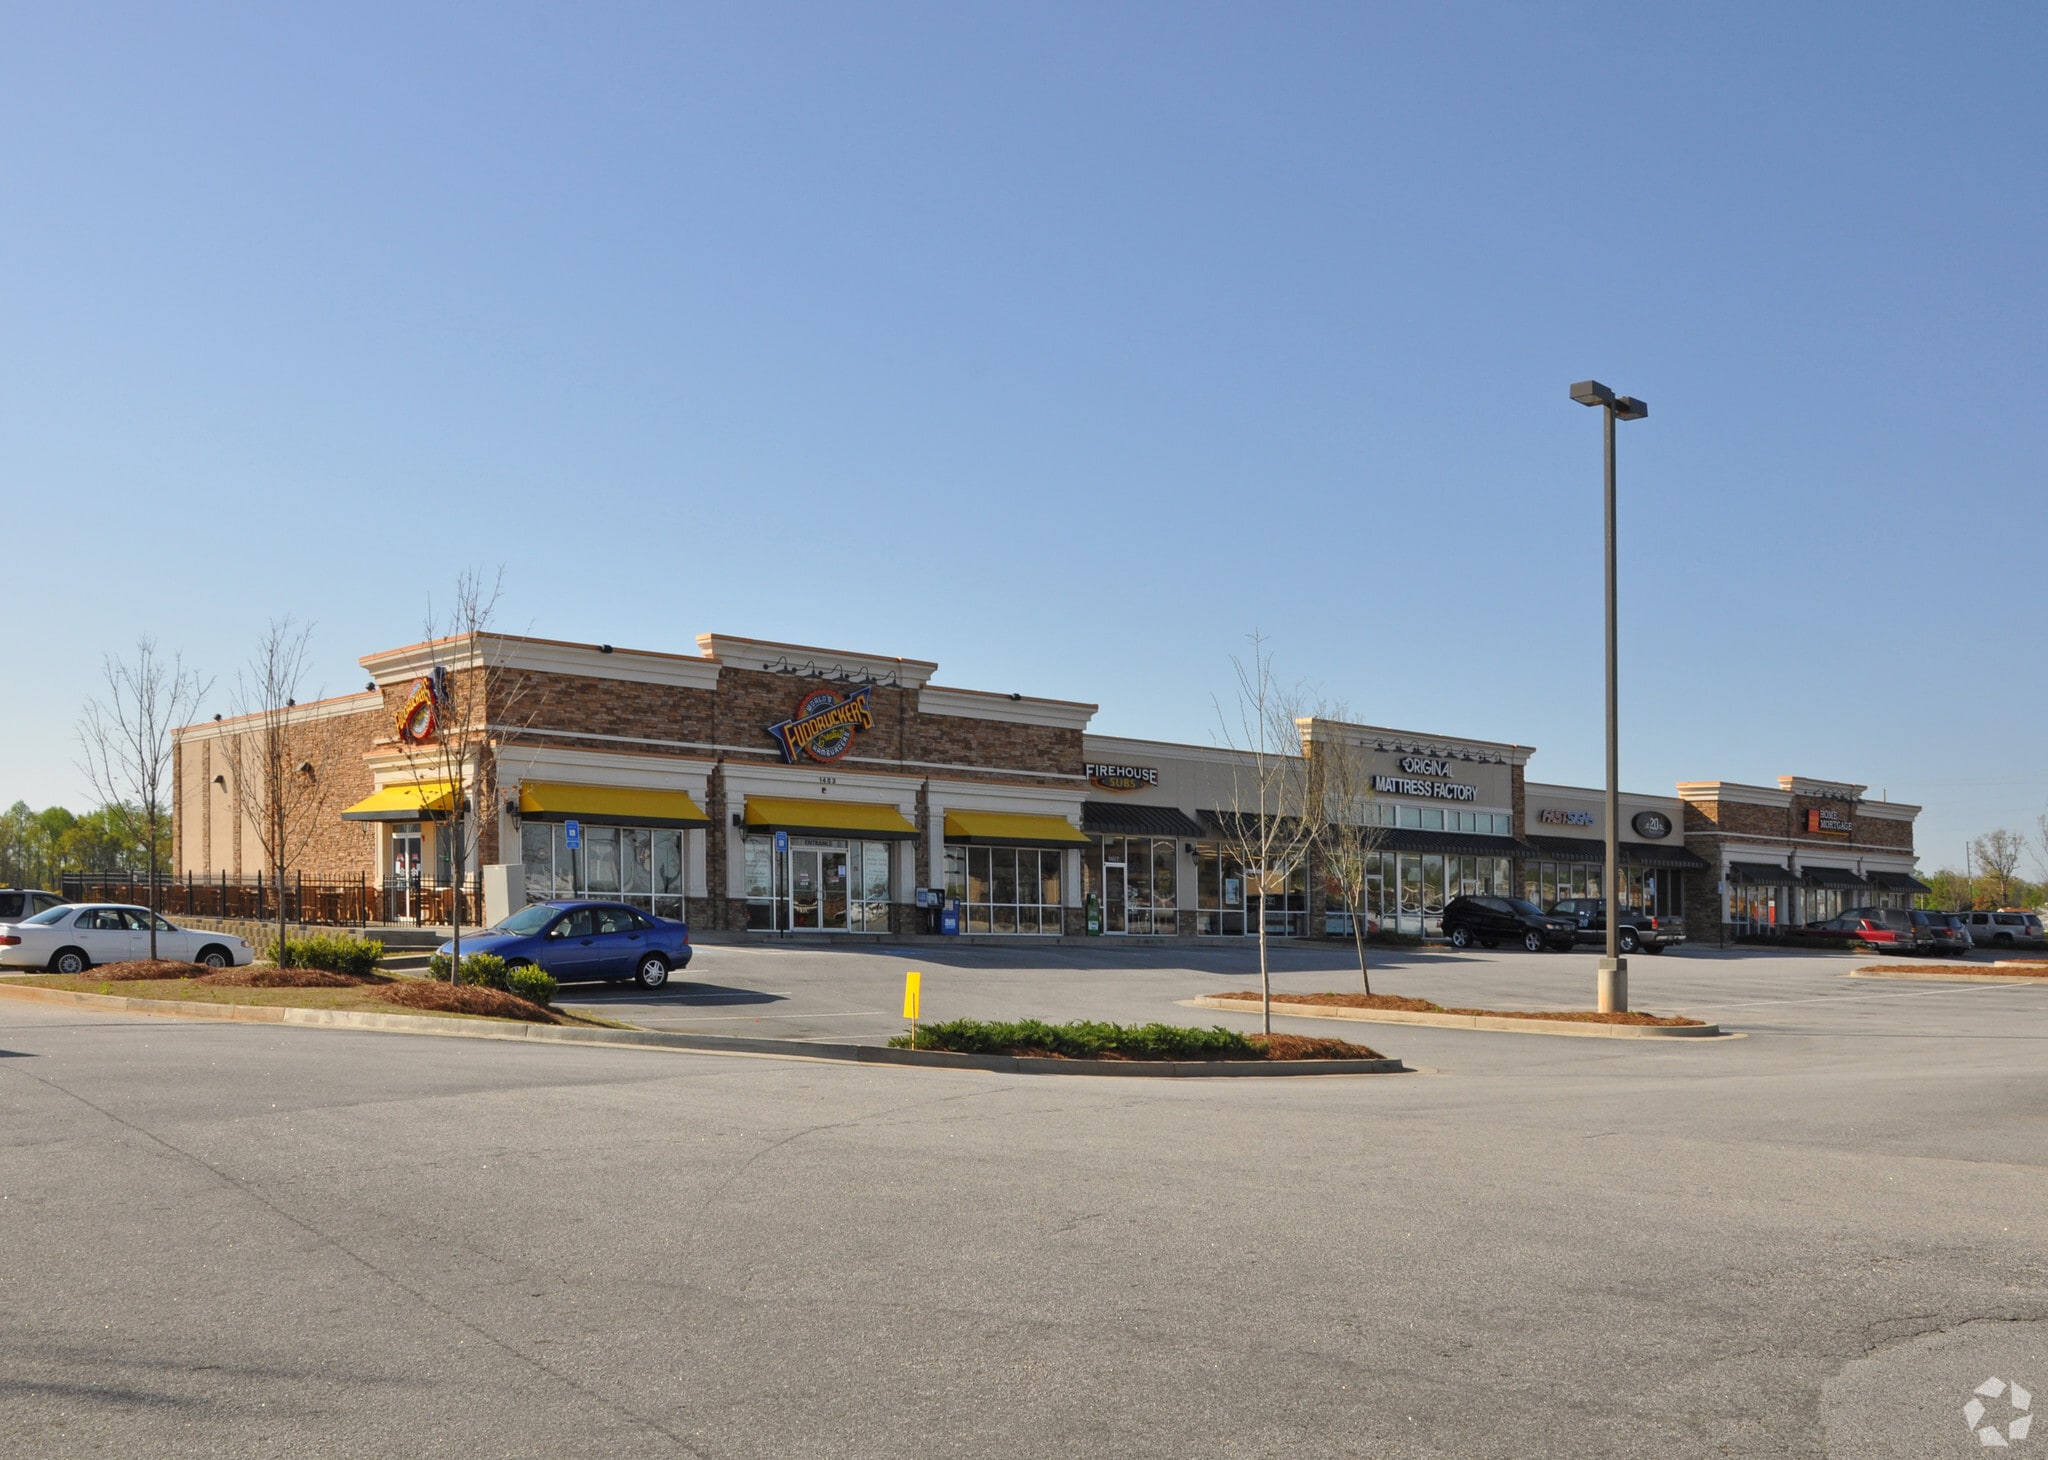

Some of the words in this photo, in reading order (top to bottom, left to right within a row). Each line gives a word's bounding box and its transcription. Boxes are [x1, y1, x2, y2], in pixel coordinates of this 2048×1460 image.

[783, 695, 873, 761] FUDDRUCKERS
[812, 731, 850, 757] HAMBURGERS
[1086, 764, 1157, 785] FIREHOUSE
[1403, 757, 1454, 777] ORIGINAL
[1110, 777, 1136, 788] SUBS
[1376, 775, 1432, 796] MATTRESS
[1433, 782, 1478, 800] FACTORY
[1649, 817, 1659, 831] 20
[1820, 810, 1837, 820] HOME
[1820, 820, 1852, 831] MORTGAGE
